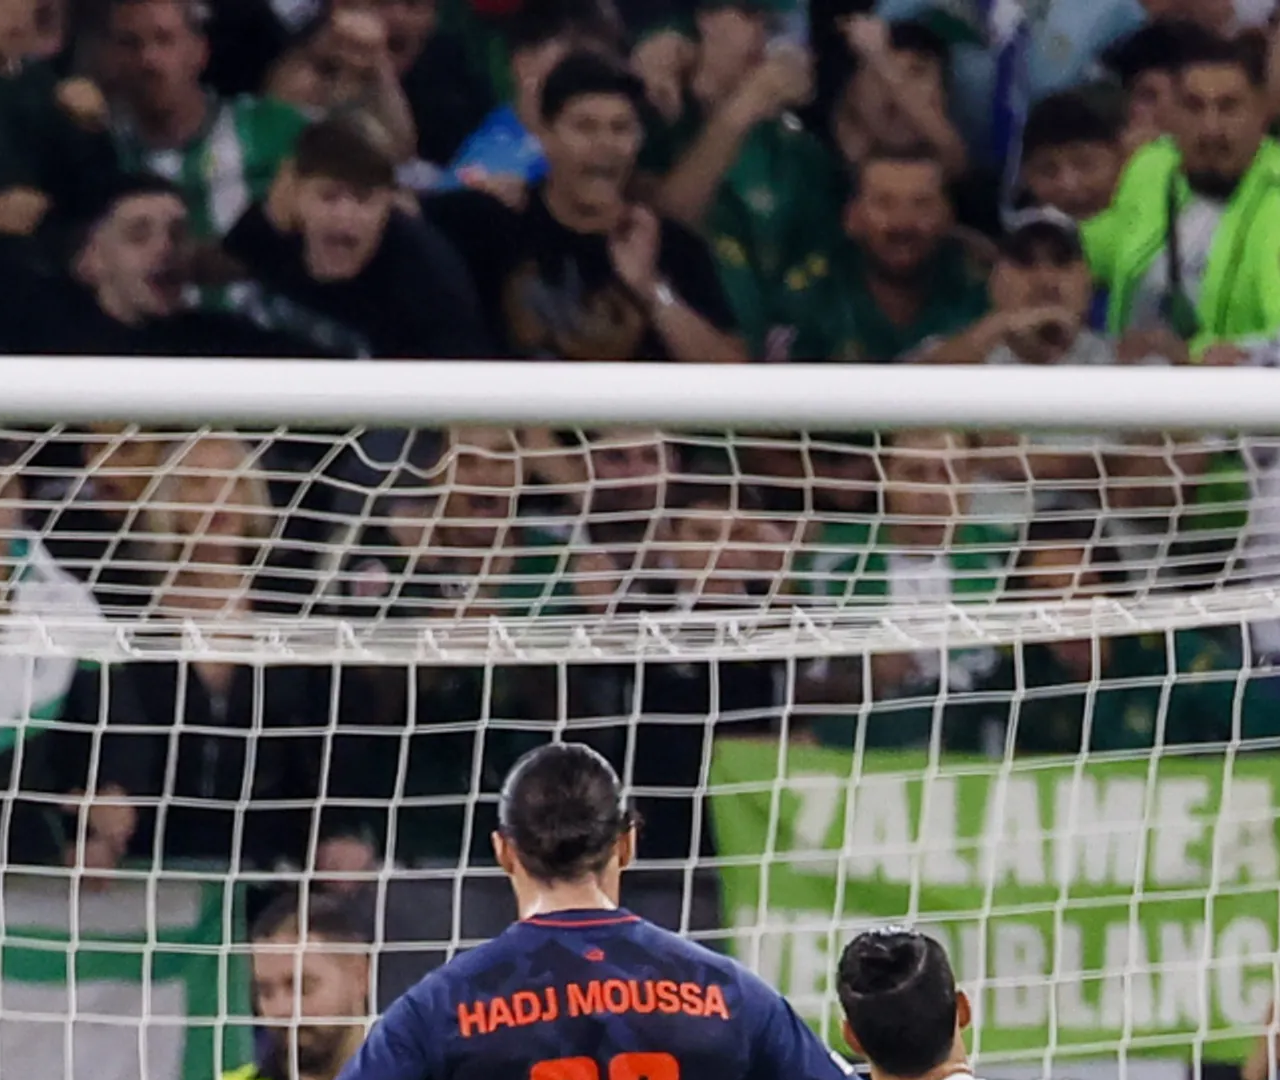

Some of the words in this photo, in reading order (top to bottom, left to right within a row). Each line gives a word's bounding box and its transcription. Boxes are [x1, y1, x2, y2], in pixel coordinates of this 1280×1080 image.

[785, 772, 1279, 888] ZALAMEA
[457, 986, 559, 1037] HADJ
[566, 979, 730, 1020] MOUSSA
